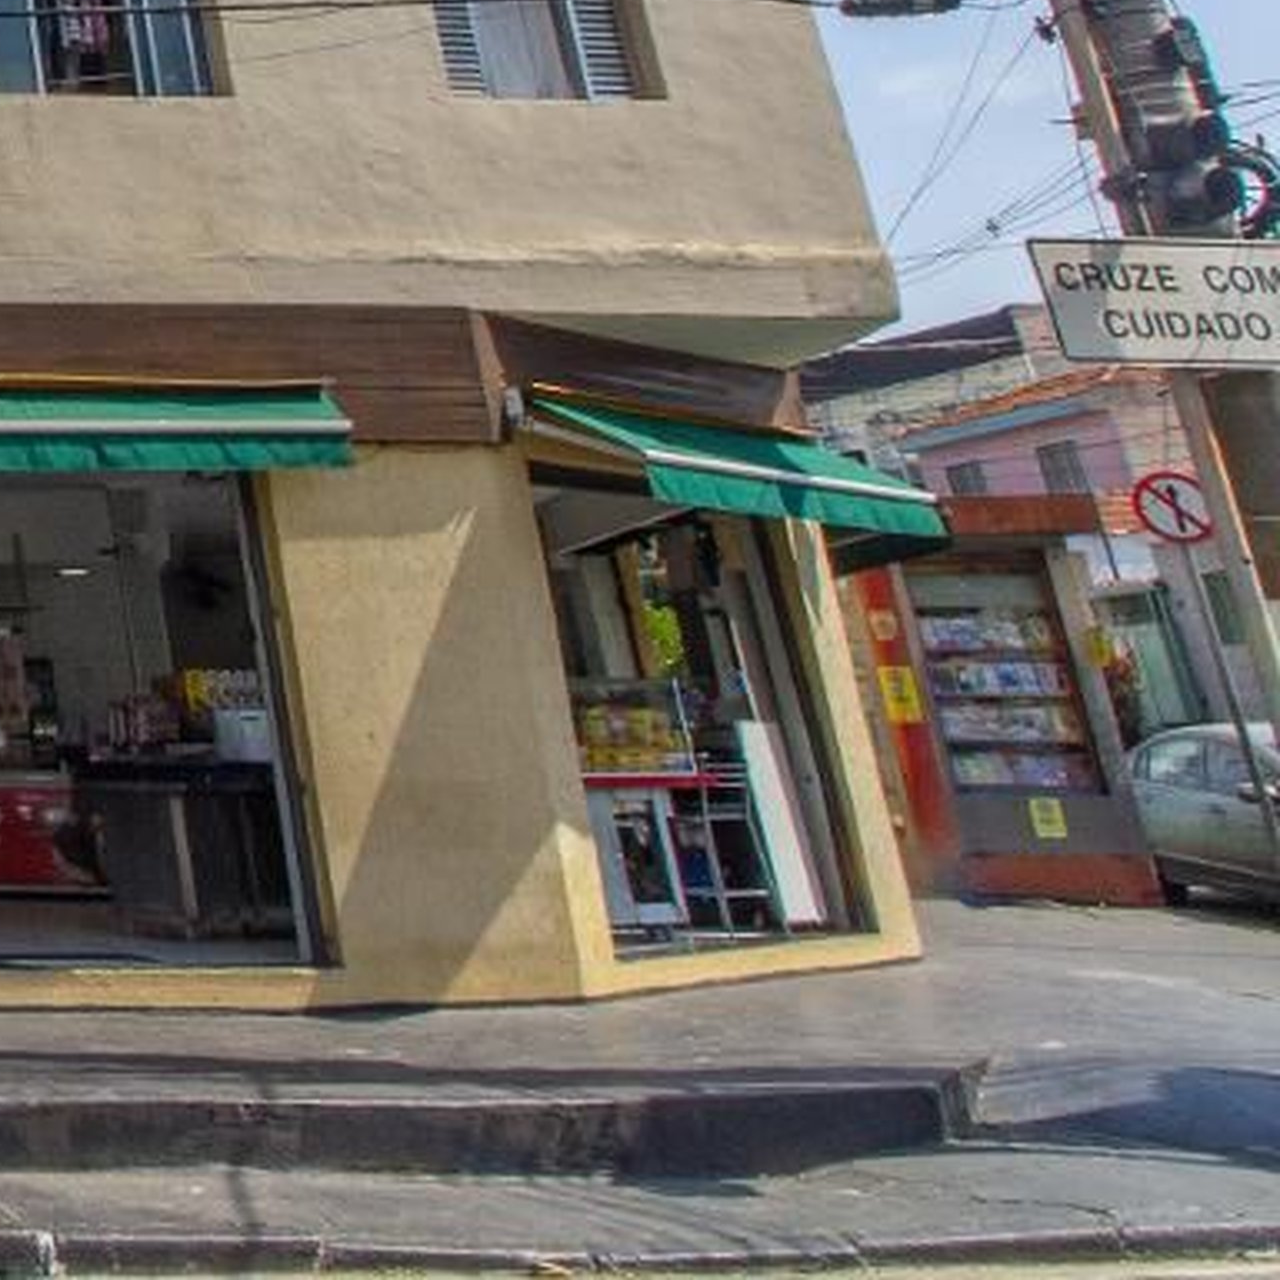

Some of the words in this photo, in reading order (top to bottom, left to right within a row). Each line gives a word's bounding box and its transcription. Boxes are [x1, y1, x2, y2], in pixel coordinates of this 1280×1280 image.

[1055, 262, 1179, 292] CRUZE
[1202, 266, 1280, 294] COM
[1102, 309, 1271, 341] CUIDADO
